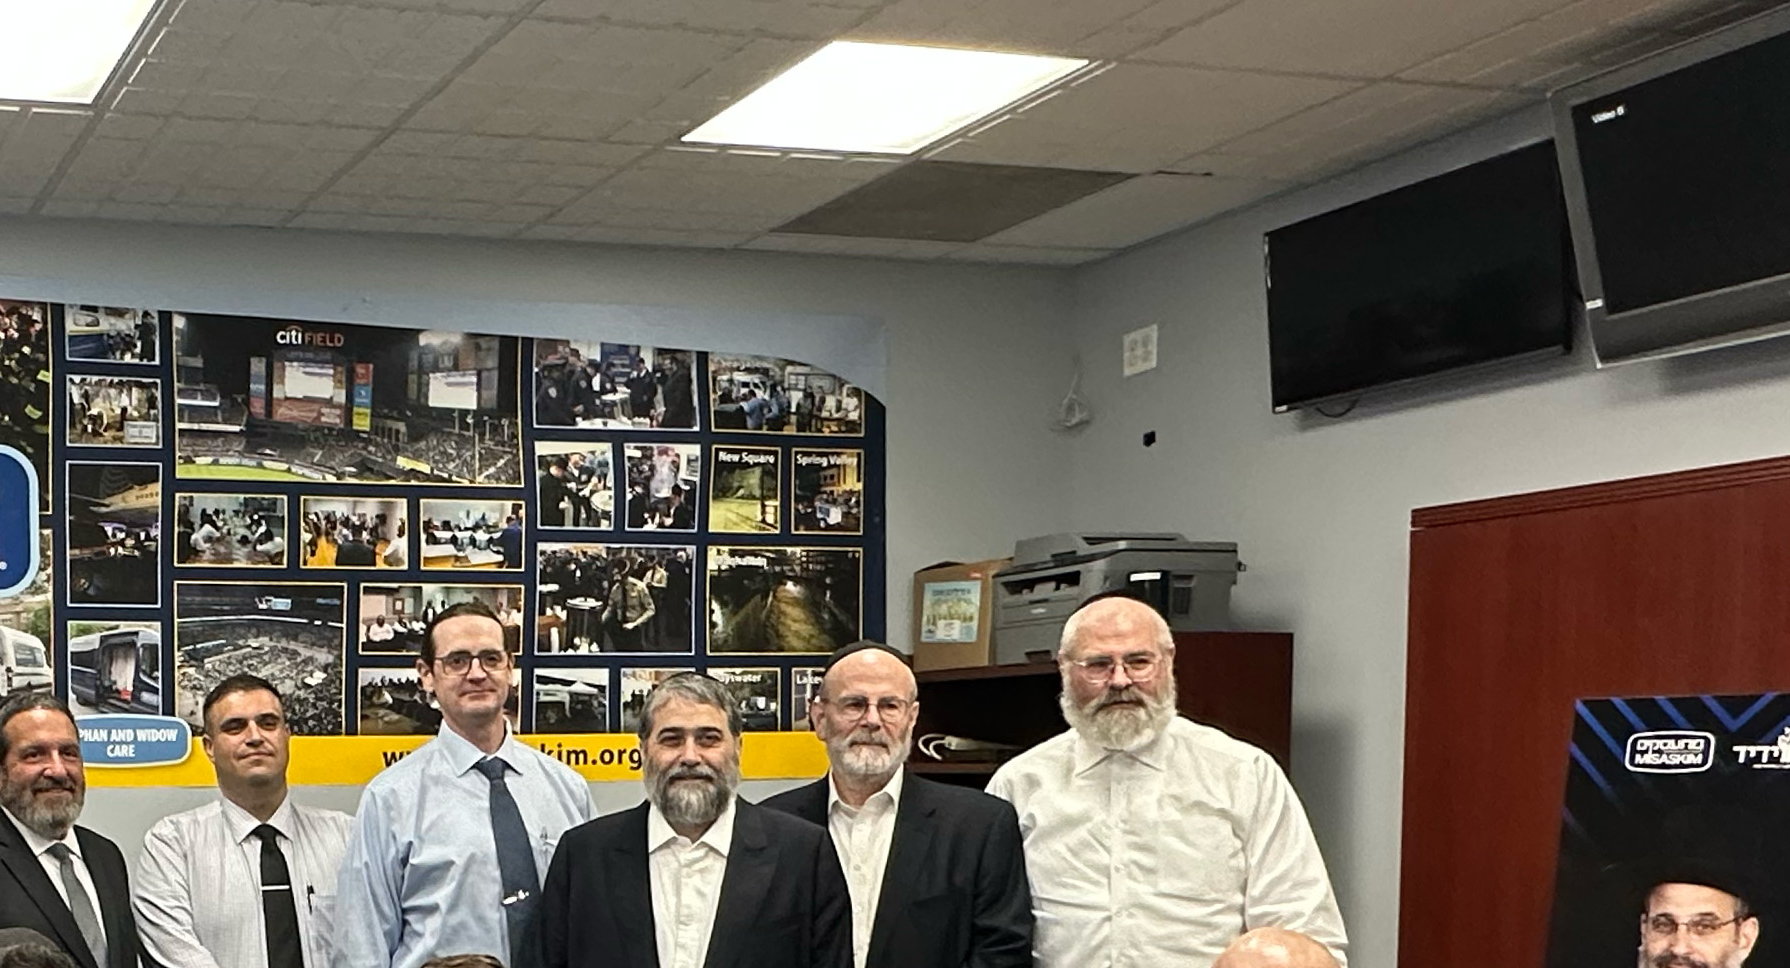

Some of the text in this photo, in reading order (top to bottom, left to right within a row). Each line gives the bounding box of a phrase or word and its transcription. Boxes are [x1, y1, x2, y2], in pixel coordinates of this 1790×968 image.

[276, 328, 344, 347] citi FIELD
[718, 451, 775, 465] New Square
[796, 454, 828, 467] Spring
[716, 672, 762, 685] ayswater
[78, 729, 178, 743] PHAN AND WIDOW
[106, 744, 136, 758] CARE
[1634, 753, 1703, 765] MISASKIM
